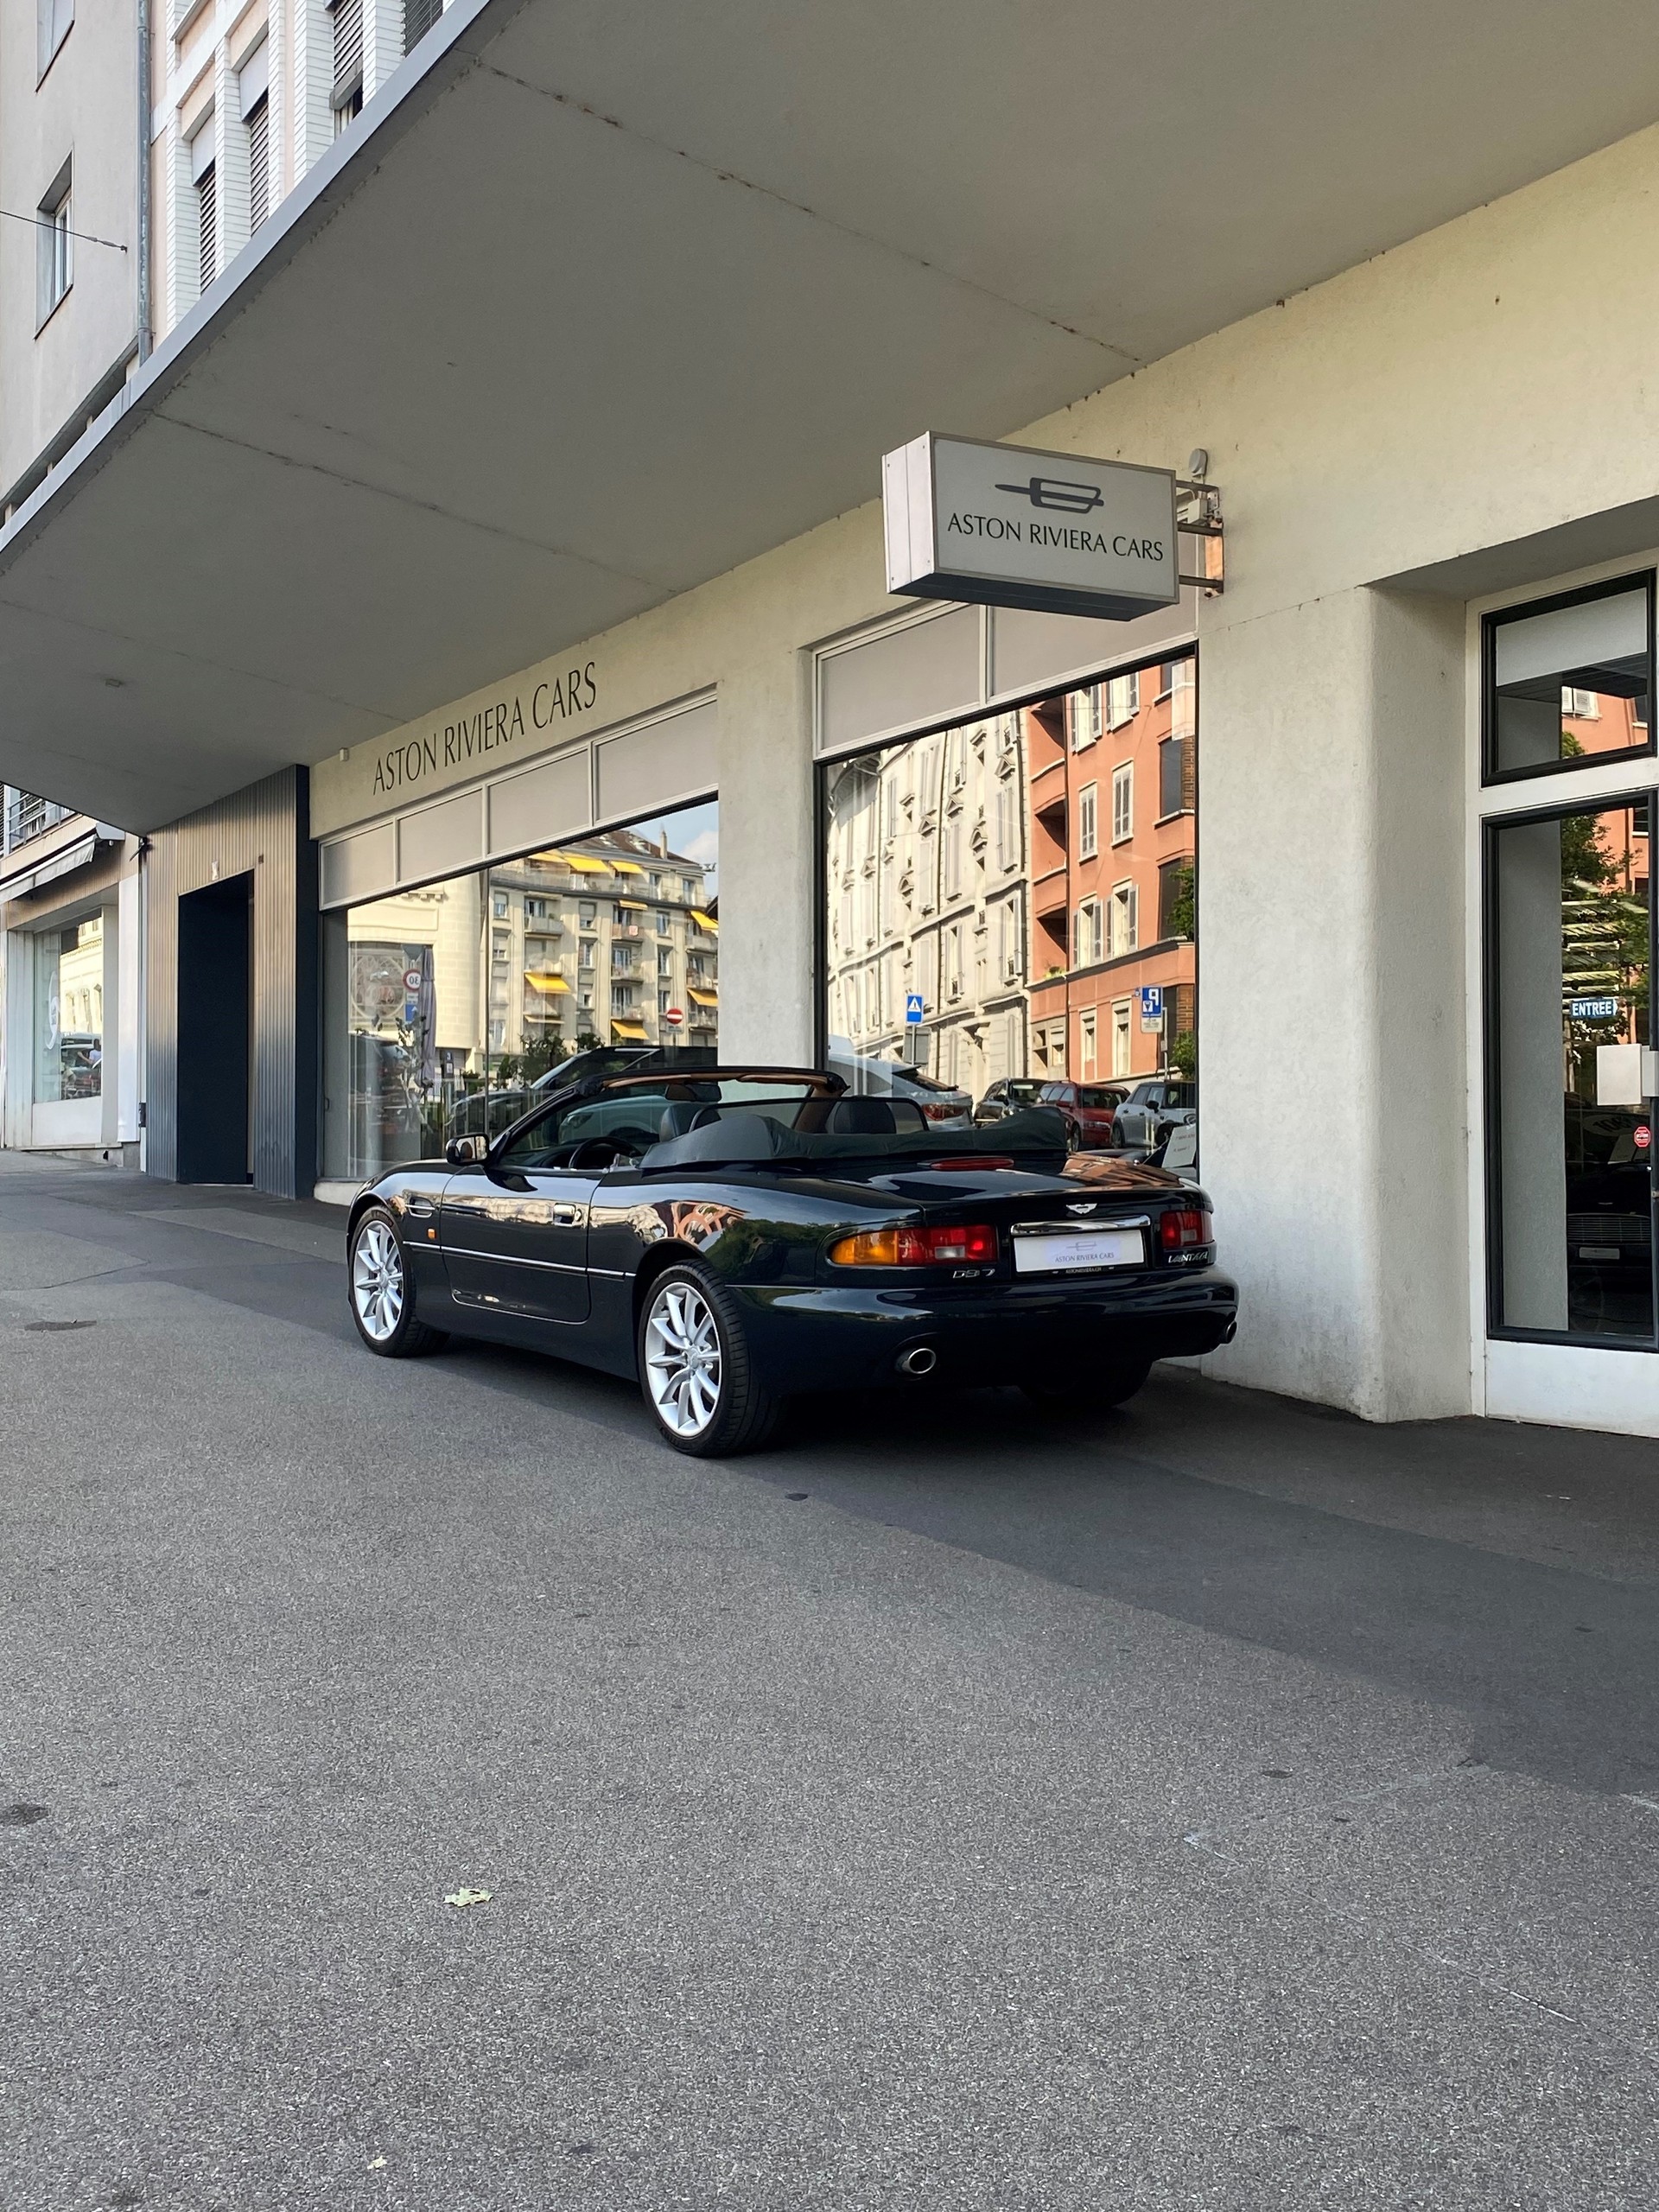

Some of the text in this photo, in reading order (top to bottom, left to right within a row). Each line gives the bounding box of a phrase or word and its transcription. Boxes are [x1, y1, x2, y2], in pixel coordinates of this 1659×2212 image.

[947, 512, 1164, 562] ASTON RIVIERA CARS
[372, 661, 596, 796] ASTON RIVIERA CARS
[1572, 1001, 1612, 1016] ENTREE
